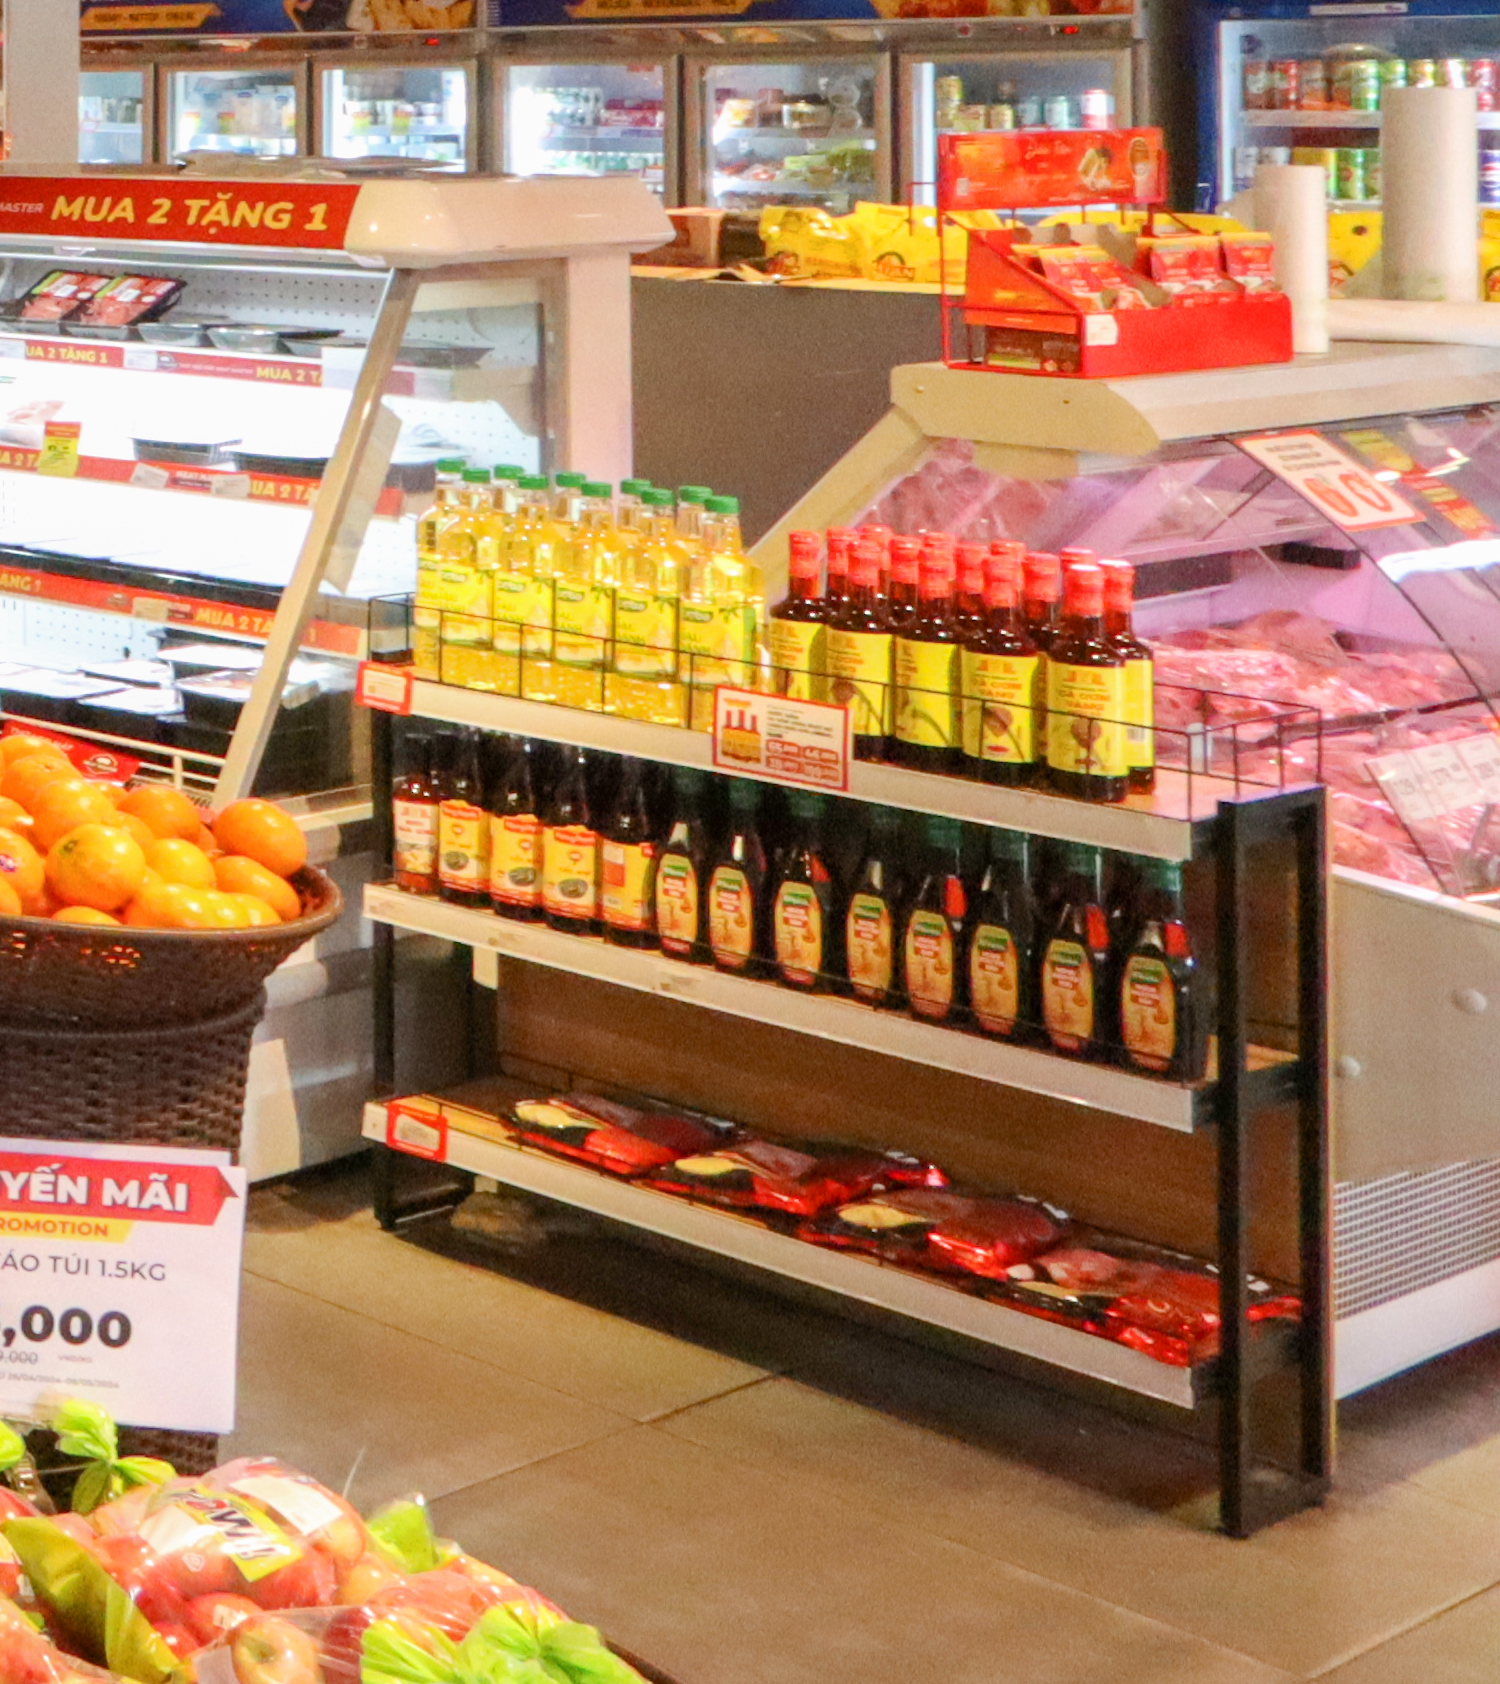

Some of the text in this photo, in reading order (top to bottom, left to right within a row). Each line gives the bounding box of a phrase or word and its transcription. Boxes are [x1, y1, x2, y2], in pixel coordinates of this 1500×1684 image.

[50, 196, 135, 223] MUA
[147, 198, 168, 224] 2
[185, 193, 292, 235] TẶNG
[303, 203, 328, 231] 1
[48, 347, 55, 358] 2
[256, 366, 291, 381] MUA
[297, 368, 305, 382] 2
[15, 452, 24, 466] 2
[195, 608, 234, 626] MUA
[102, 1173, 188, 1212] MÃI
[49, 1253, 90, 1276] TÚI
[99, 1259, 166, 1281] 1.5KG
